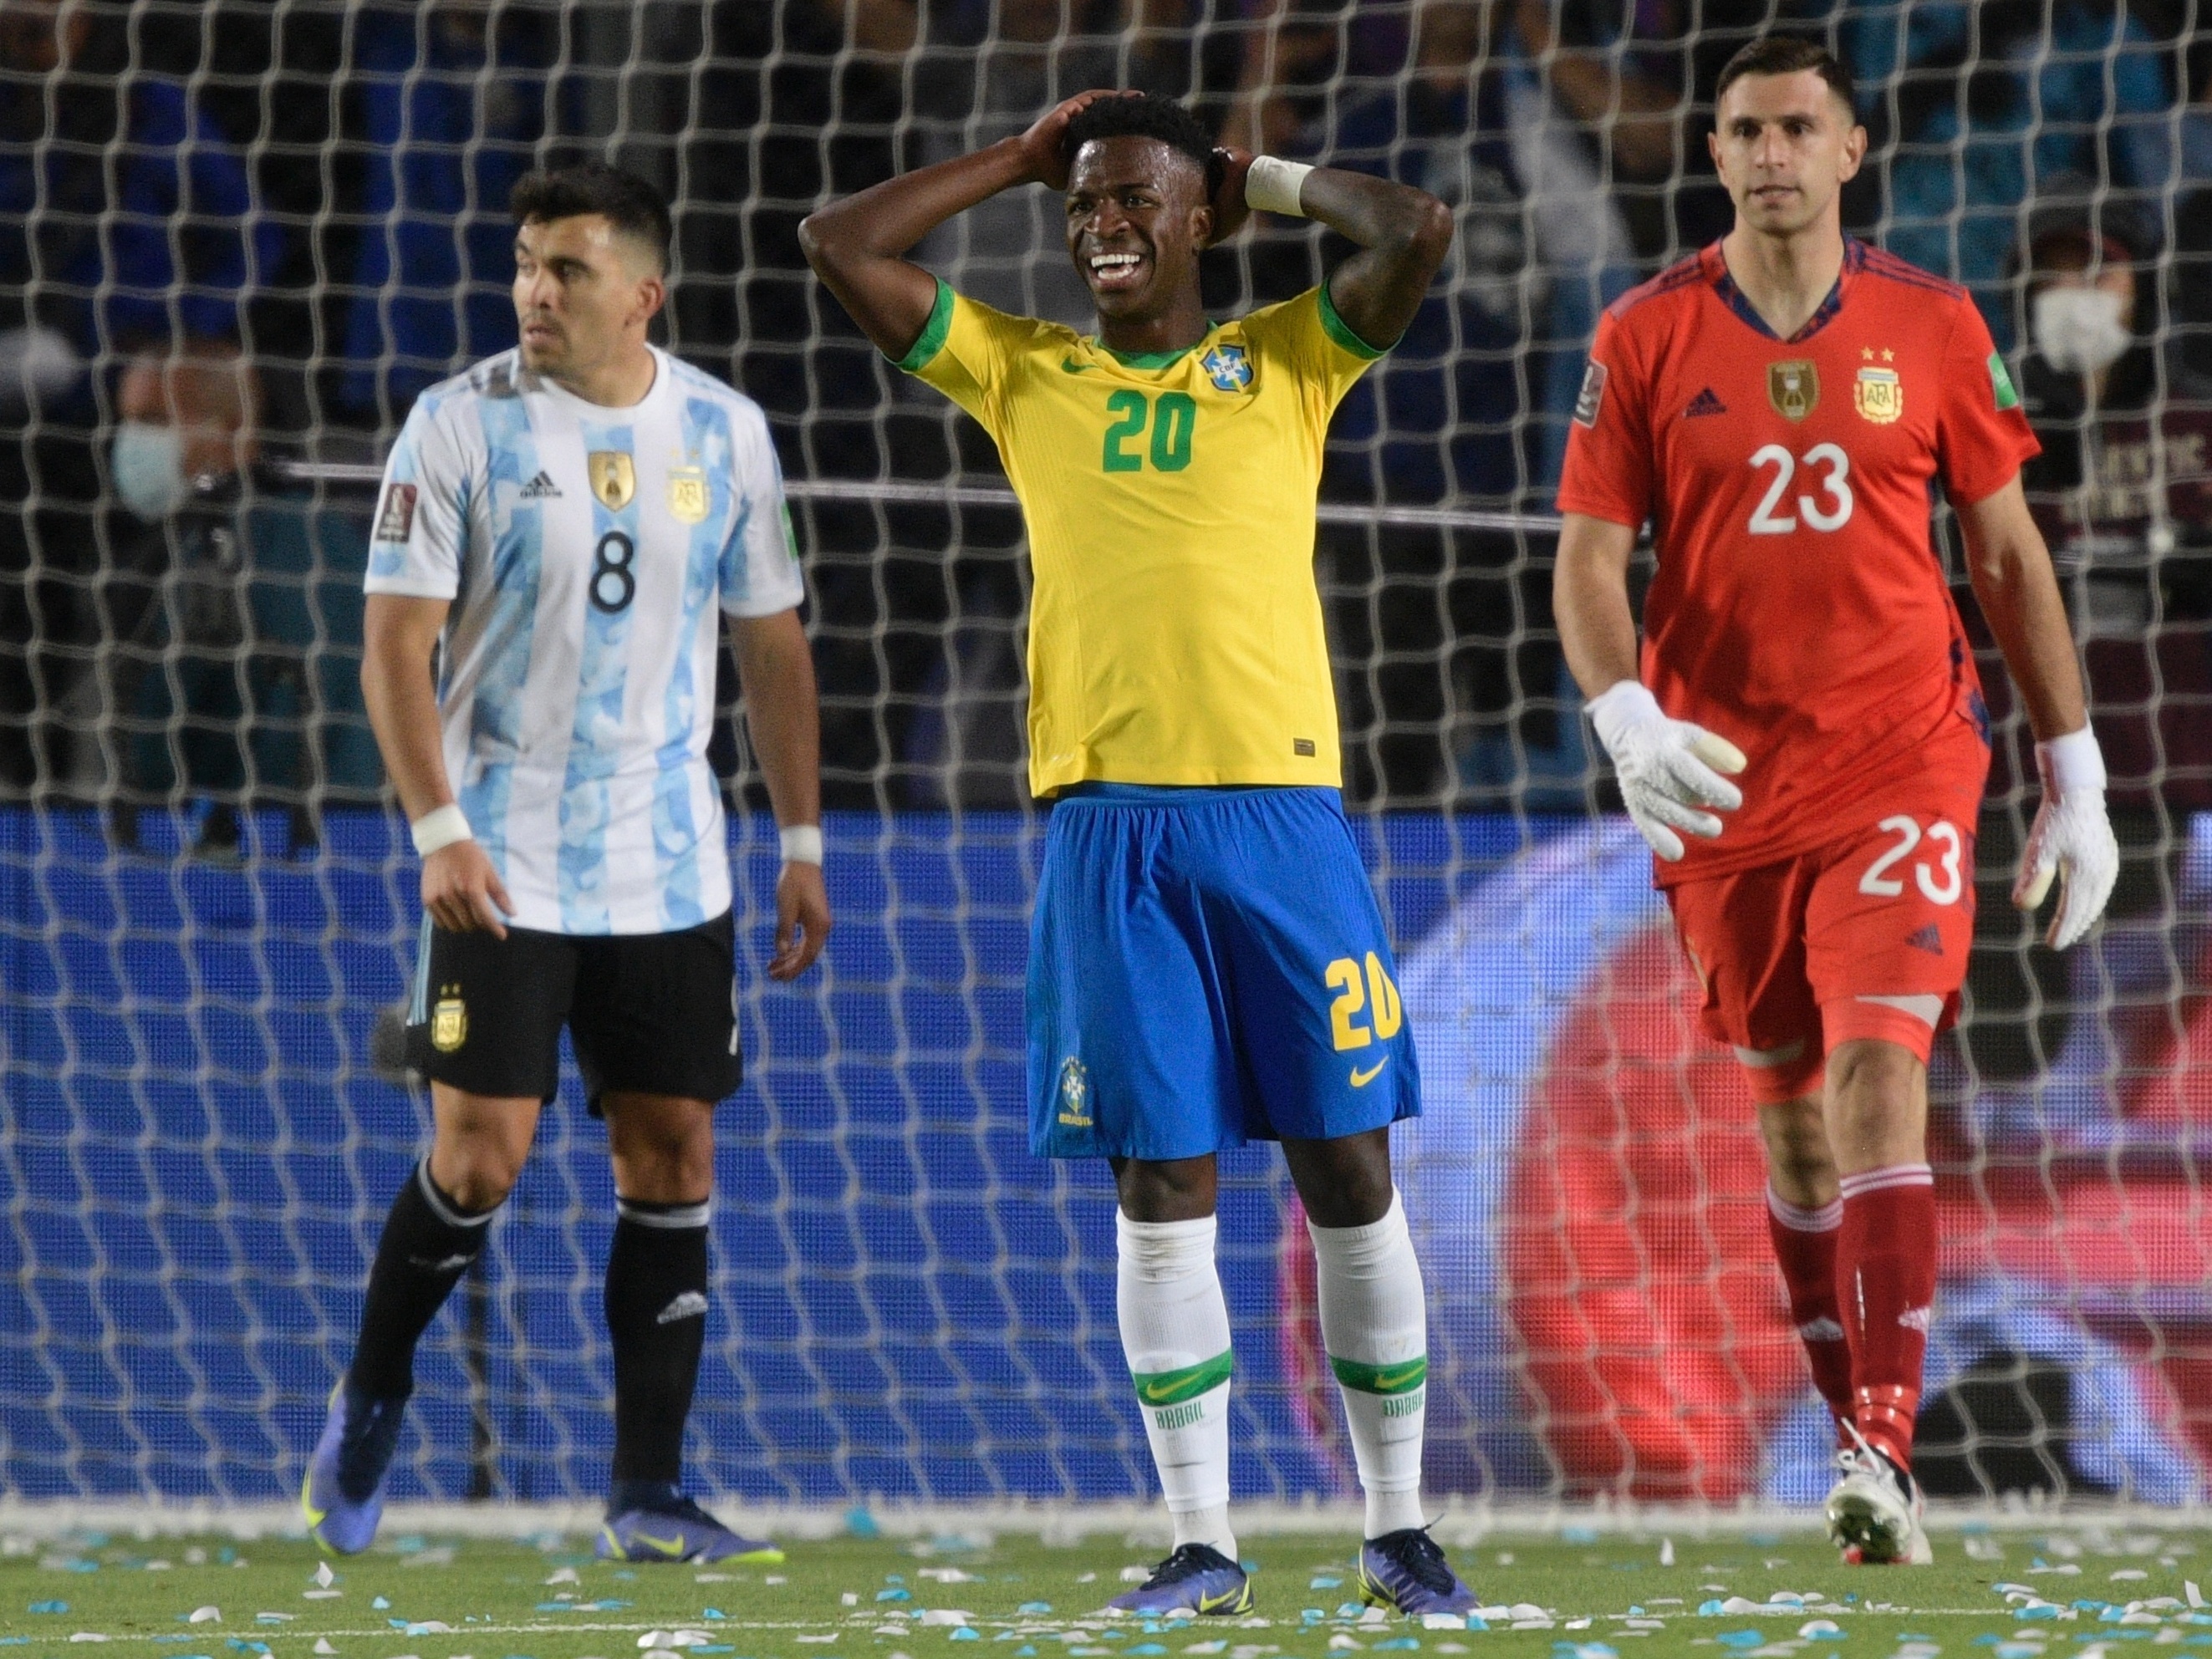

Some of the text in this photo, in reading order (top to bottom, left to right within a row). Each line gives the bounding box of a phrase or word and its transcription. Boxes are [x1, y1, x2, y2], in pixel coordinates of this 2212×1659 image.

[1102, 389, 1197, 472] 20
[1747, 441, 1854, 535] 23
[589, 530, 636, 614] 8
[1858, 813, 1962, 906] 23
[1324, 950, 1402, 1052] 20
